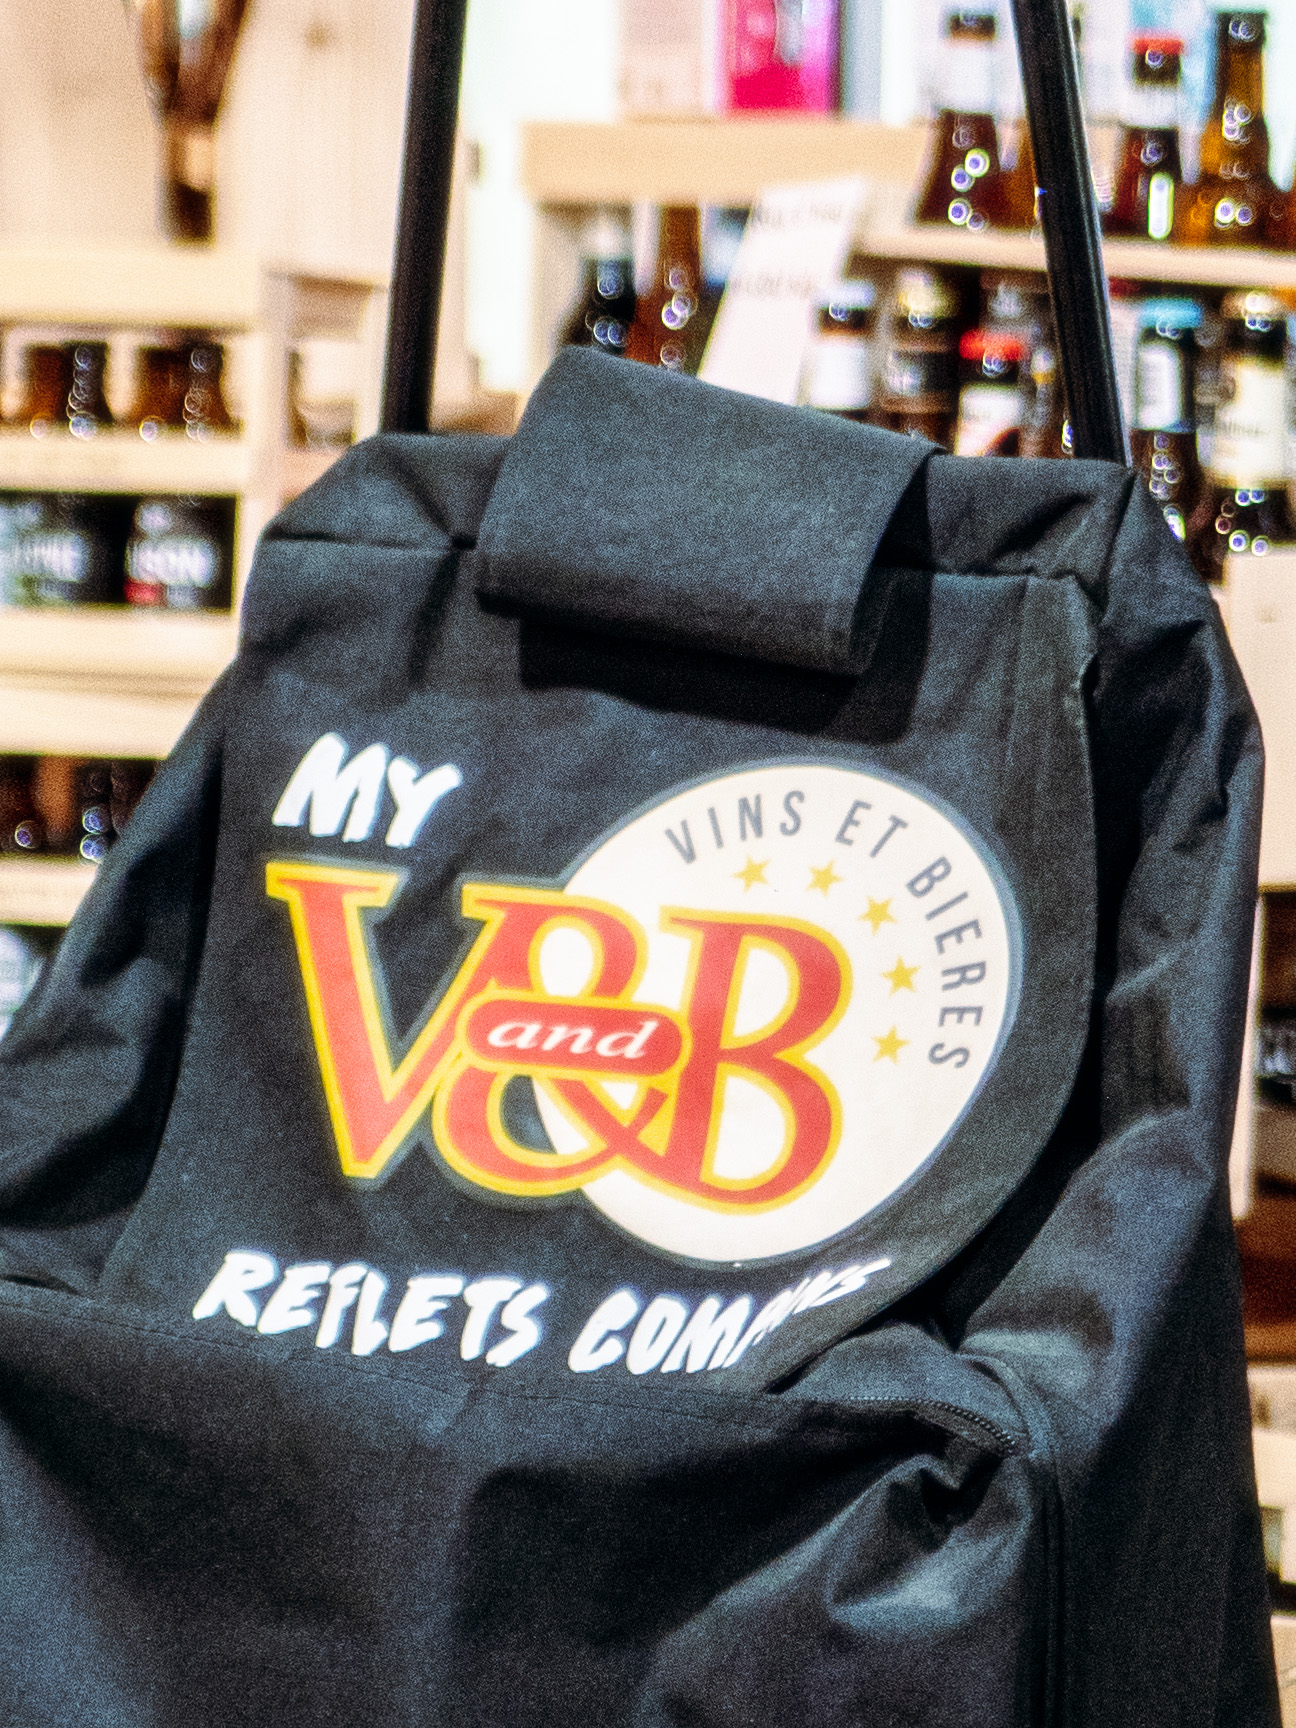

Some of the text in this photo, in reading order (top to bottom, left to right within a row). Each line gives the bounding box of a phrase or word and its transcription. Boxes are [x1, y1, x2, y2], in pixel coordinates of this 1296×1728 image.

[272, 731, 464, 849] MY
[664, 789, 988, 1069] VINS ET BIERES
[487, 1019, 658, 1060] and
[192, 1248, 551, 1368] REFLETS
